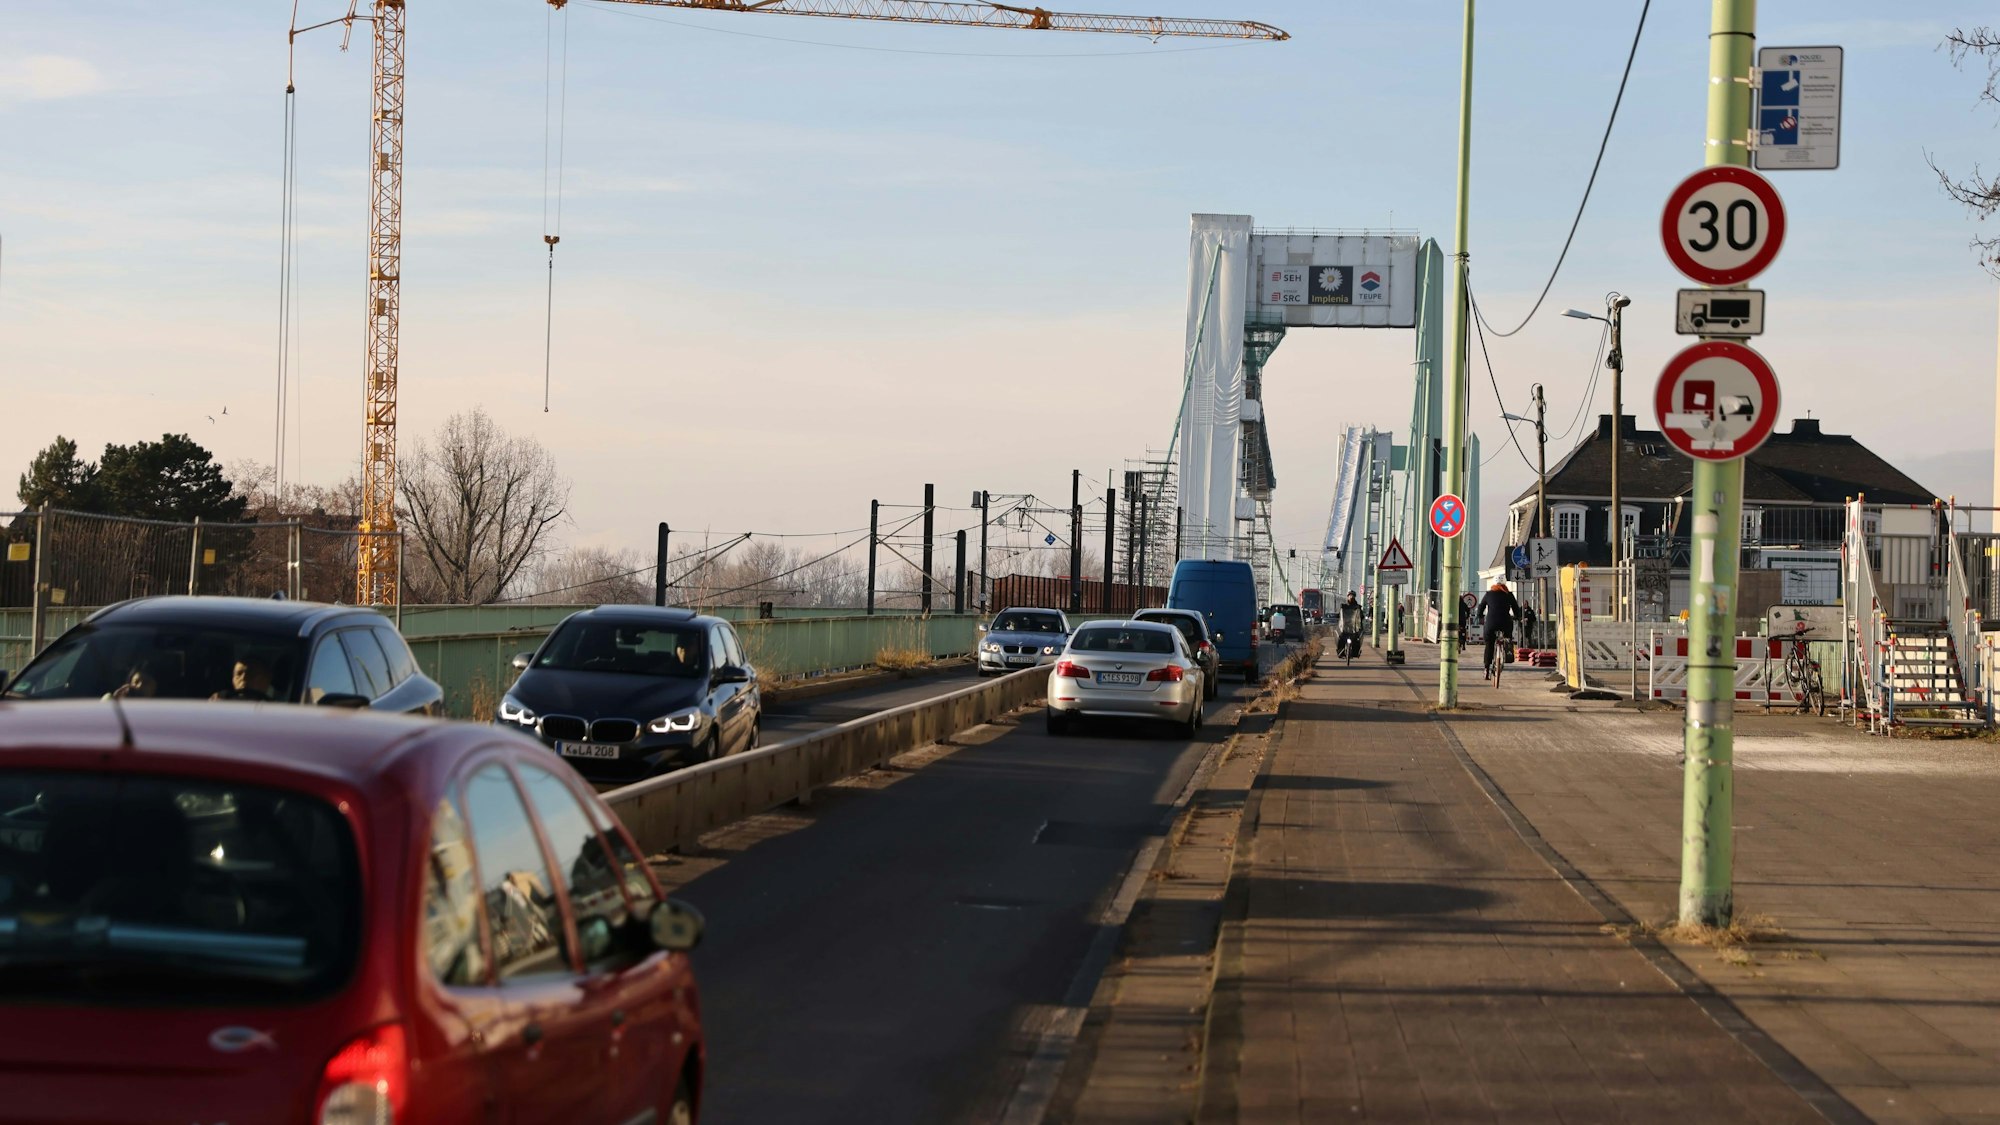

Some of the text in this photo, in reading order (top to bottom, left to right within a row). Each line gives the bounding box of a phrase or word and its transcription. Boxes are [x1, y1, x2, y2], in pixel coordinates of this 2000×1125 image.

[1688, 198, 1758, 252] 30
[1283, 274, 1302, 282] SEH
[1283, 294, 1301, 302] SRC
[1311, 294, 1349, 304] Implenia
[594, 746, 615, 757] 208
